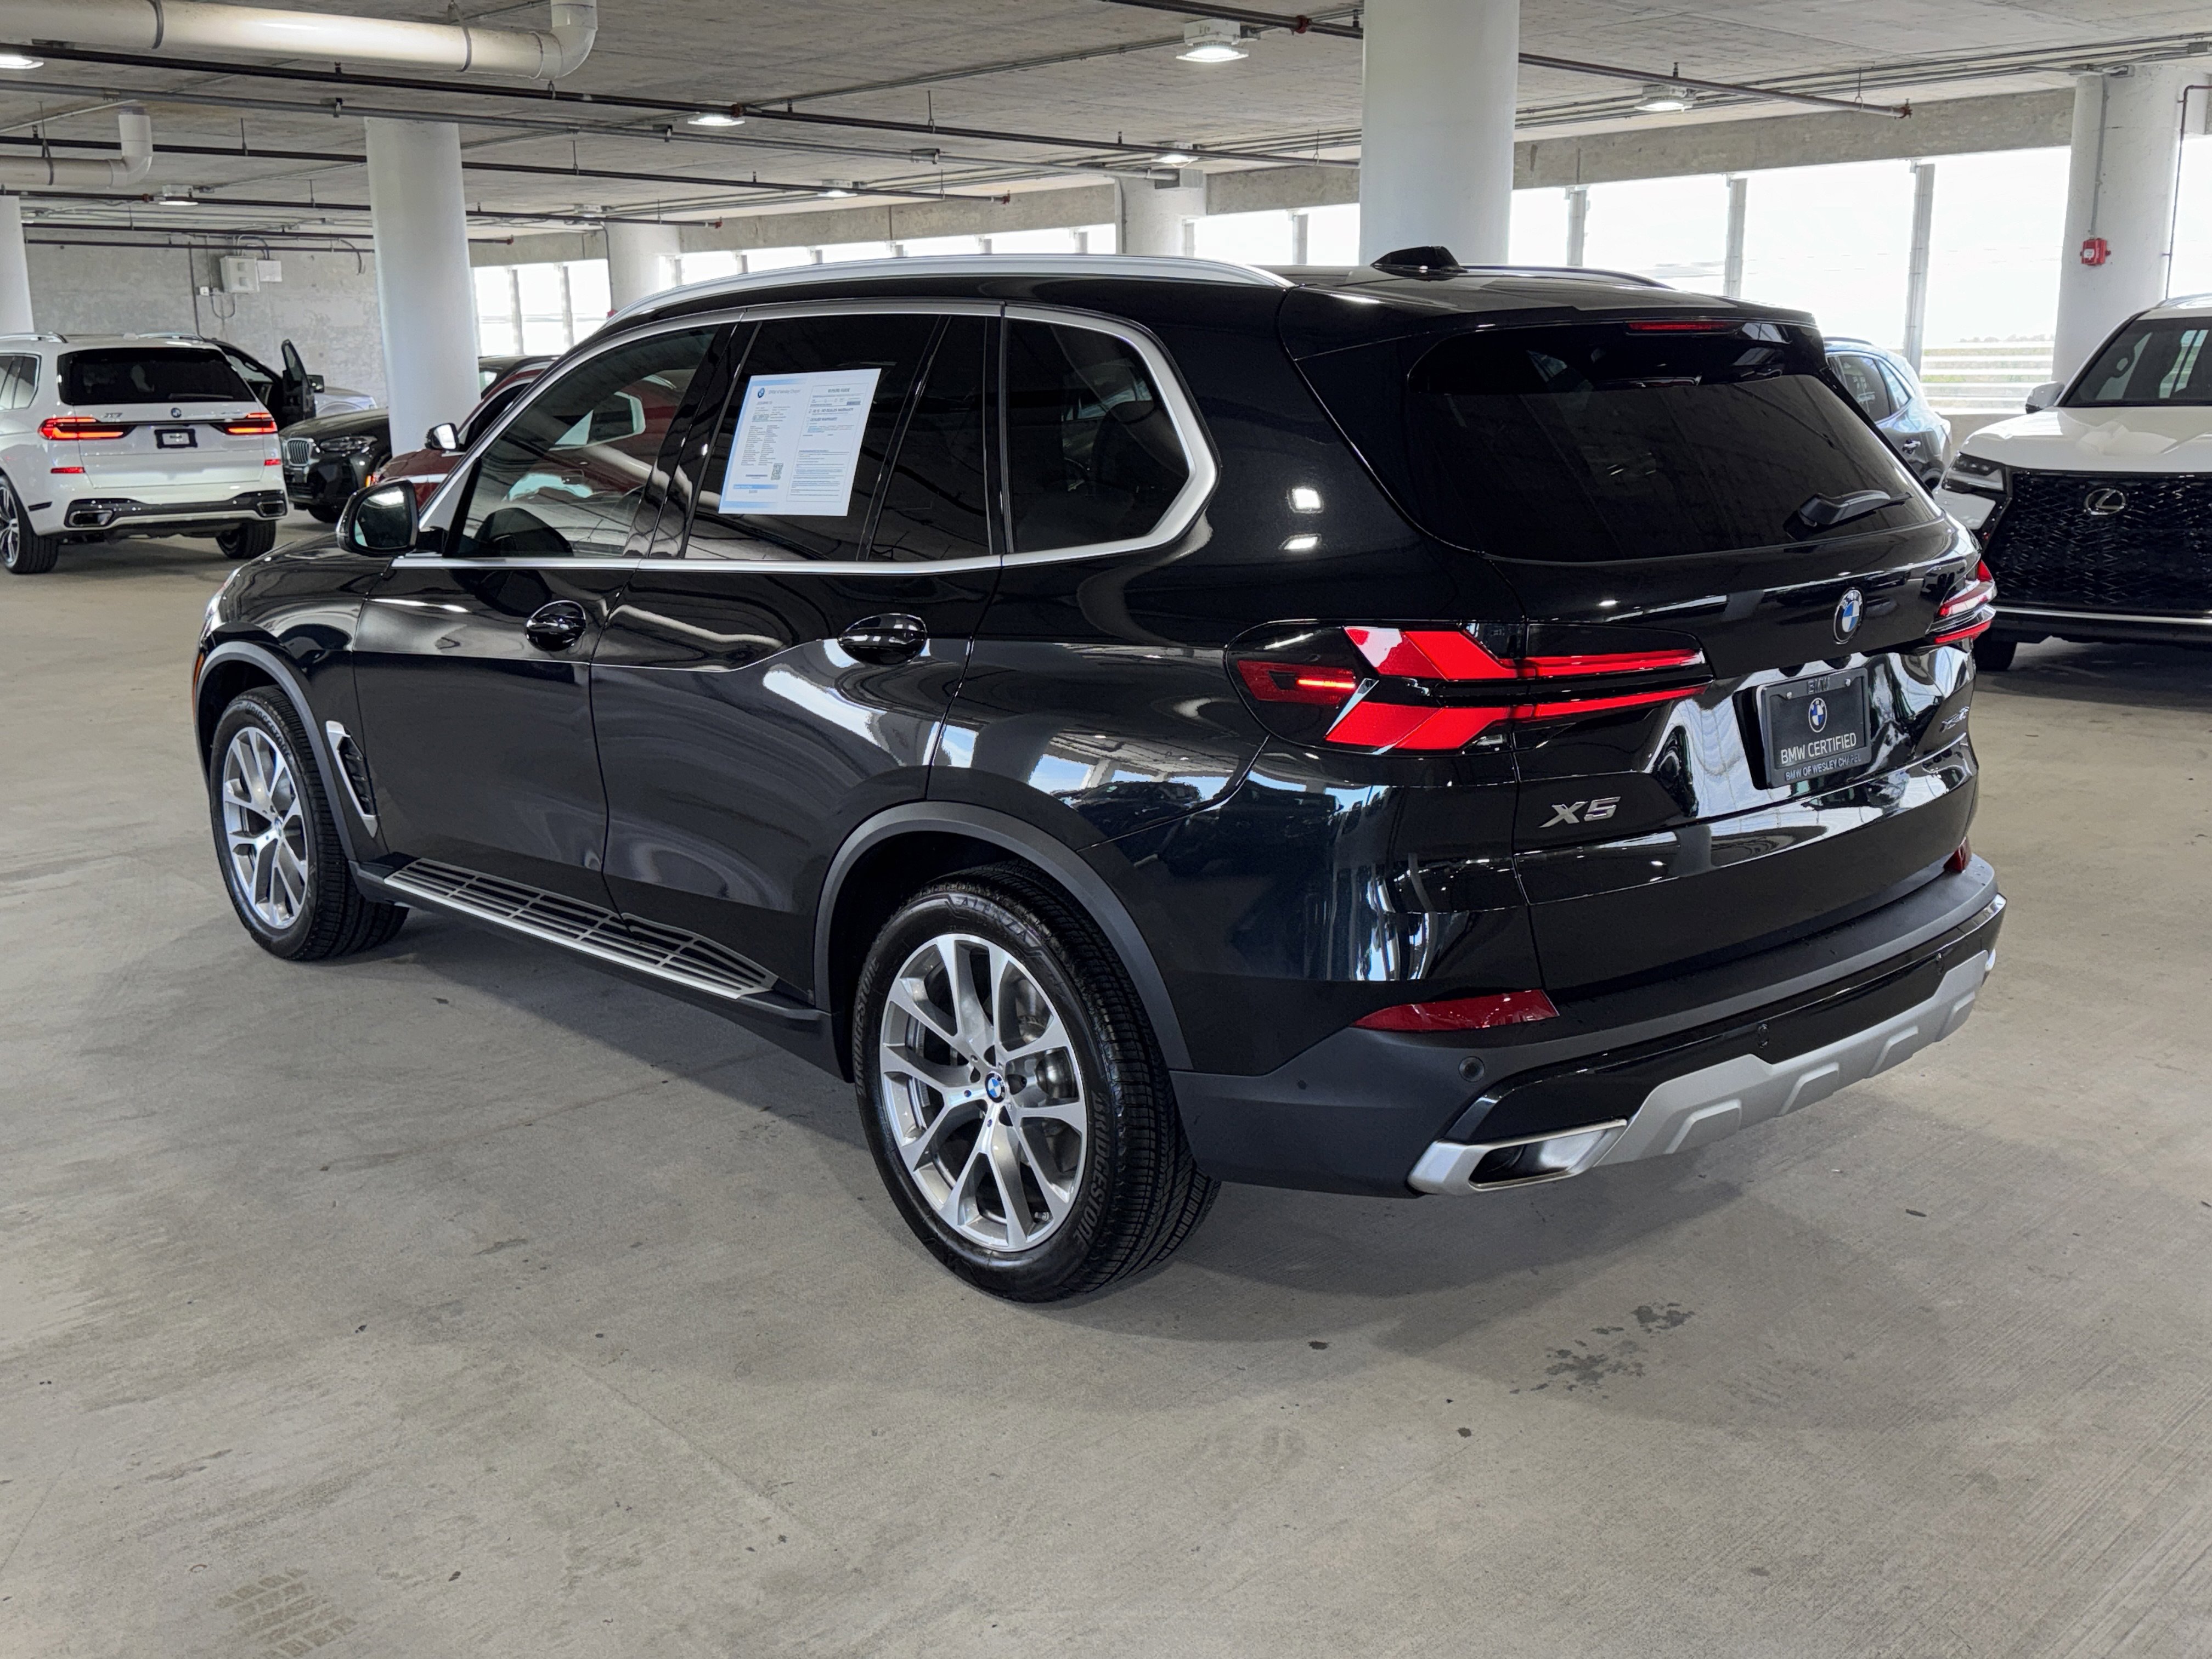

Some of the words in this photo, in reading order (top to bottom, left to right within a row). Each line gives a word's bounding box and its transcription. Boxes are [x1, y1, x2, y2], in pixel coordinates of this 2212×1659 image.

[1780, 744, 1805, 764] BMW
[1808, 732, 1857, 757] CERTIFIED
[1785, 770, 1802, 781] BMW
[1803, 766, 1812, 776] OF
[1812, 759, 1837, 774] WESLEY
[1838, 754, 1861, 768] CHAPEL
[1538, 795, 1621, 828] X5
[961, 896, 1027, 943] ALENZA
[853, 957, 879, 1096] BRIDGESTONE
[1073, 1090, 1110, 1248] BRIDGESTONE
